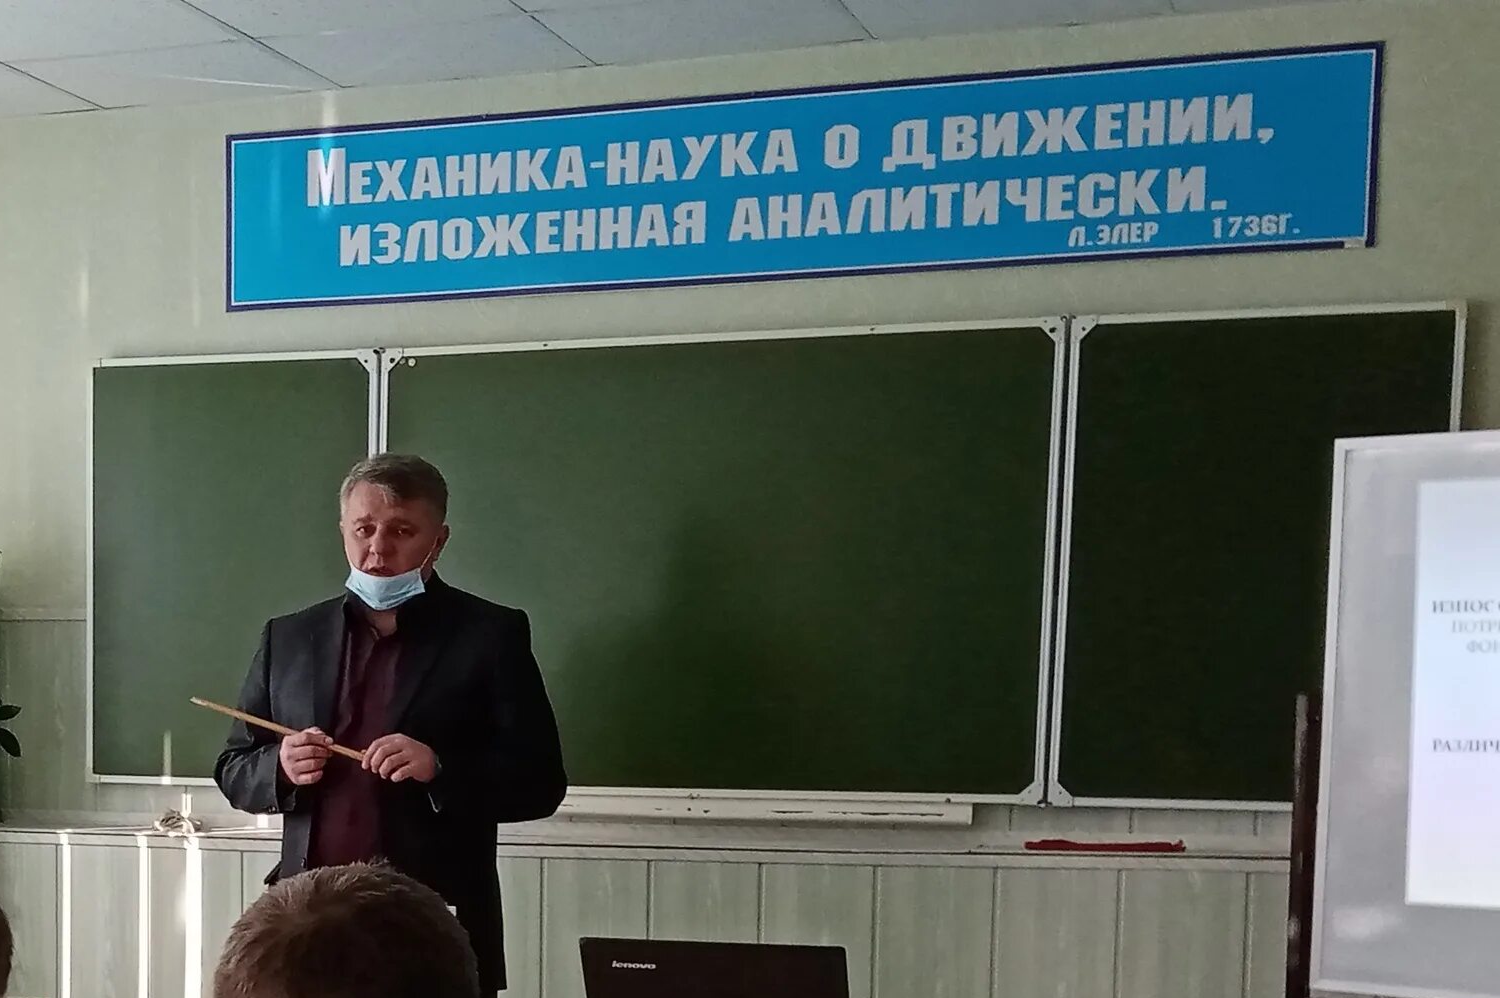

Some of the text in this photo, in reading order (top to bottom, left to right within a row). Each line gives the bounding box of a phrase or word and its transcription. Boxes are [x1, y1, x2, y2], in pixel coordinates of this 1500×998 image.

[824, 124, 860, 169] О
[881, 92, 1276, 172] ДВИЖЕНИИ,
[339, 165, 1229, 267] ИЗЛОЖЕННАЯ АНАЛИТИЧЕСКИ.
[1451, 619, 1500, 633] ПОТР
[611, 960, 656, 970] lenovo
